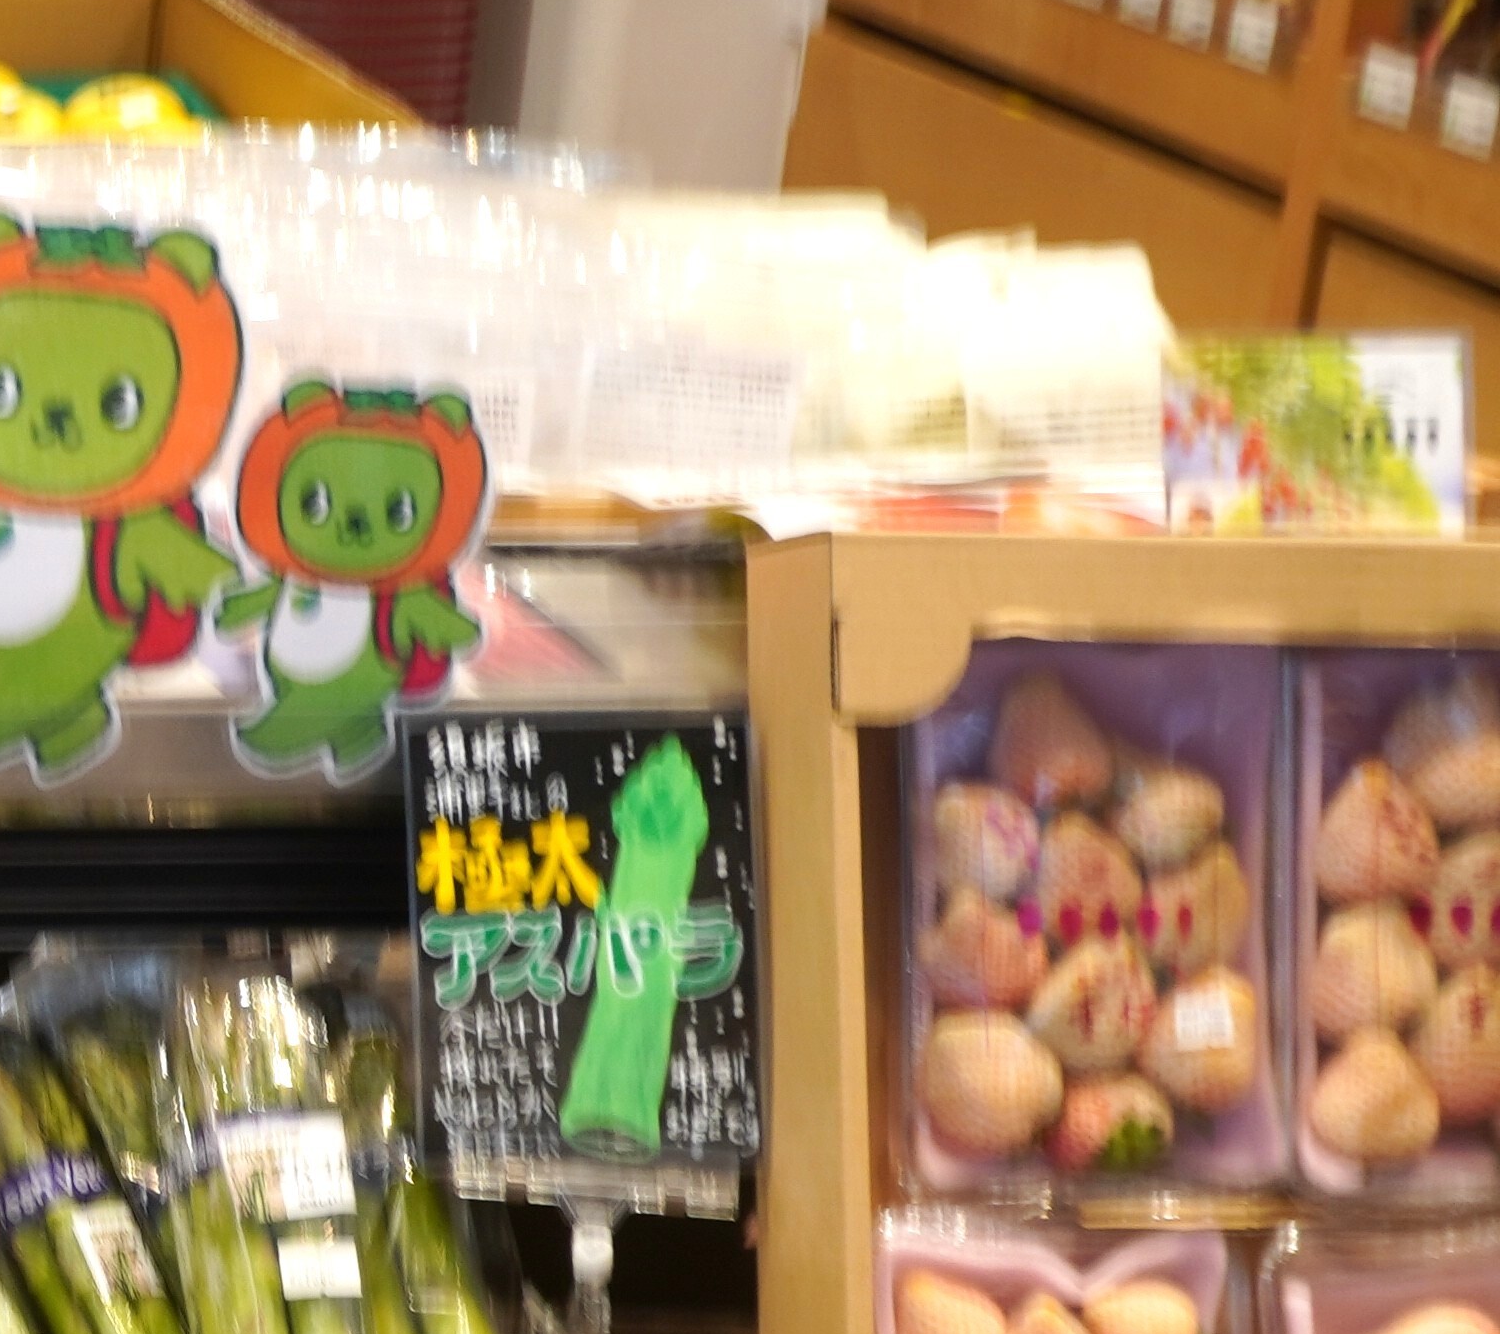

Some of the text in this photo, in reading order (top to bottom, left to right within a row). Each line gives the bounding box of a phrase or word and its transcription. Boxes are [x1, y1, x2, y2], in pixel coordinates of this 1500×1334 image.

[416, 807, 602, 915] 極太
[419, 900, 744, 1011] アスパラ
